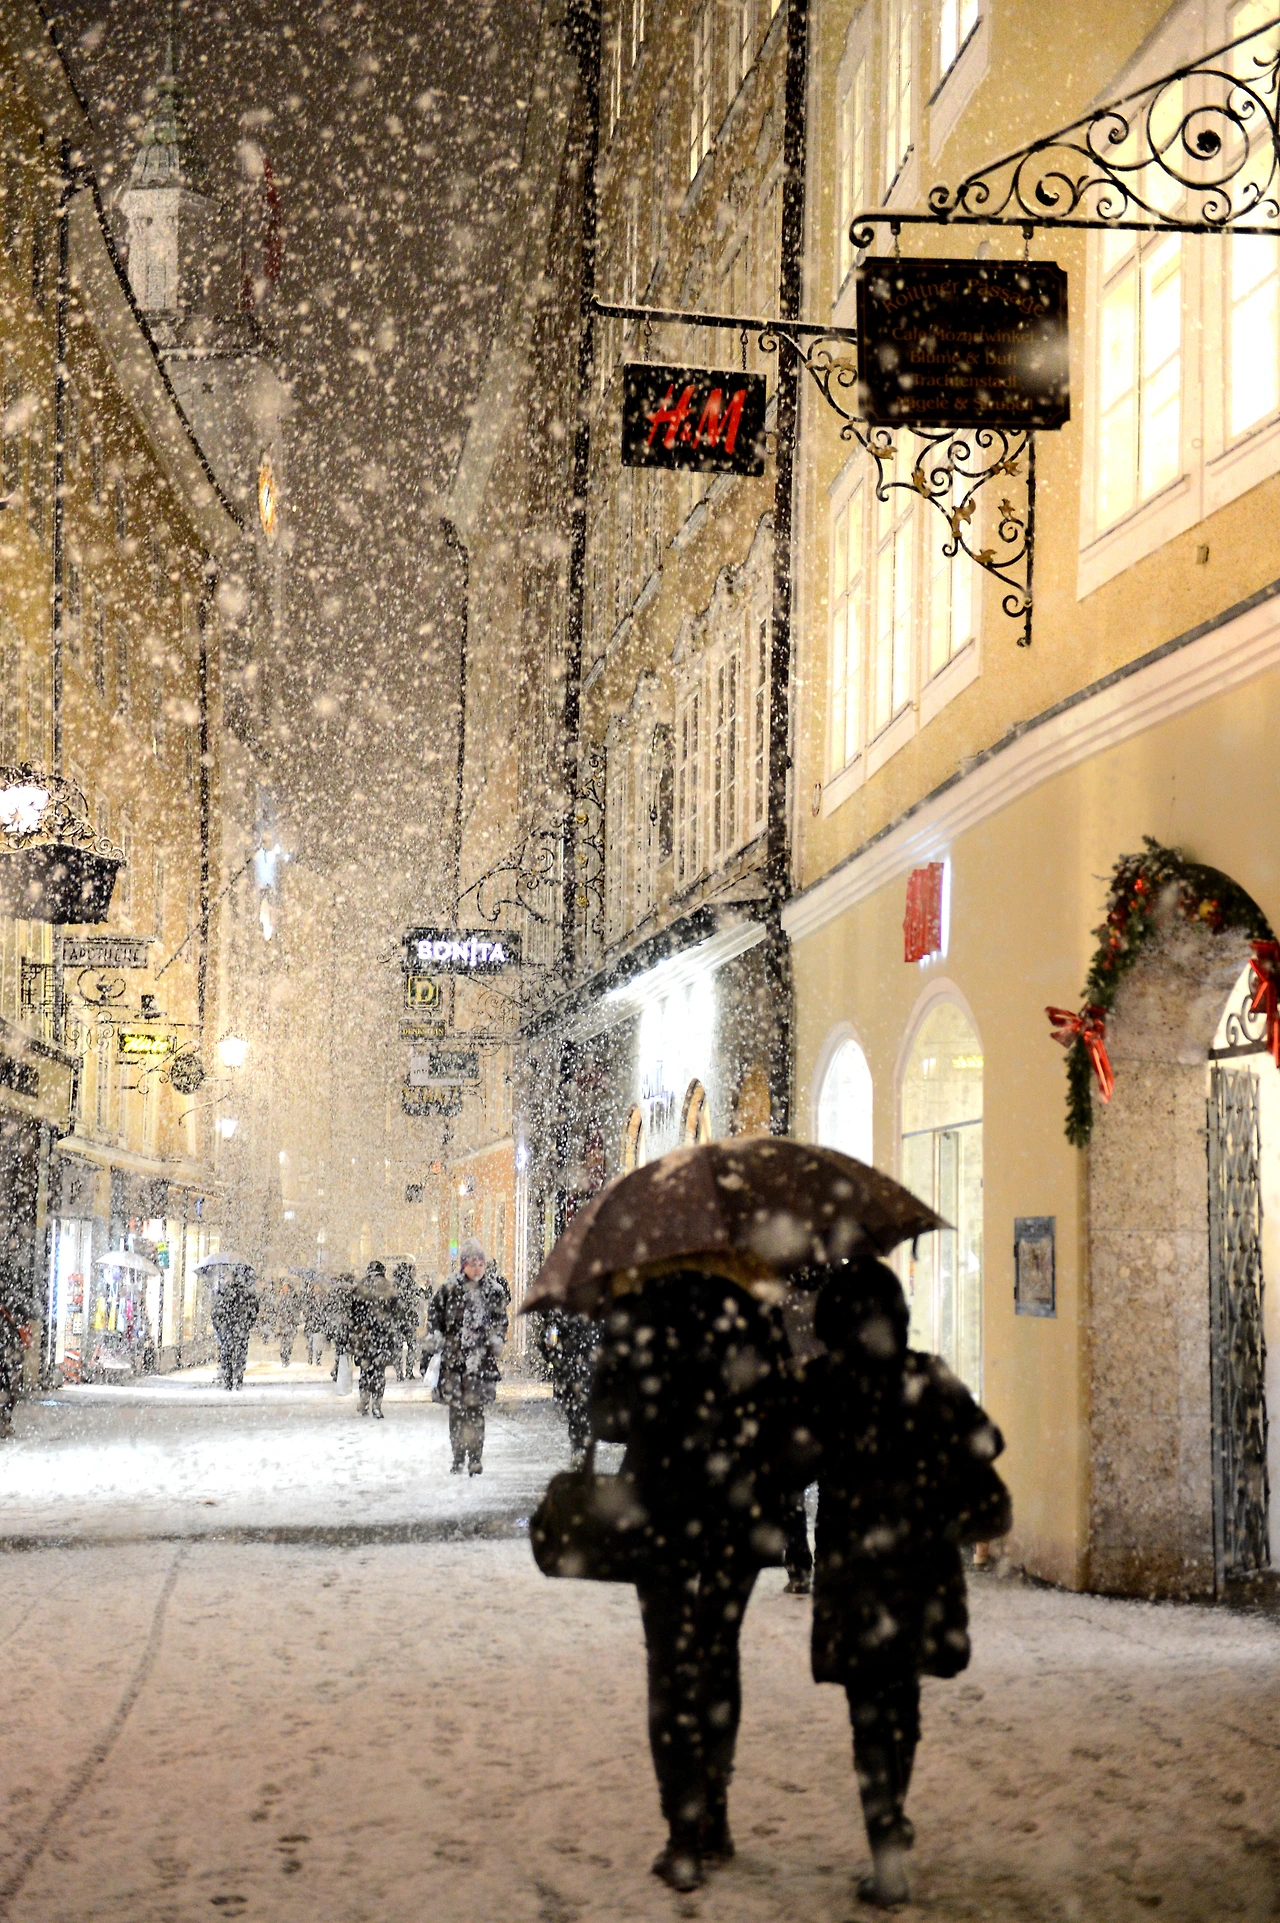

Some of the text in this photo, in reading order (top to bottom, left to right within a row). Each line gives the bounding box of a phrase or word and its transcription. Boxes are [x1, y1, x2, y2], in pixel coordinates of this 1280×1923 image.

[967, 278, 1046, 317] Passage
[965, 352, 979, 365] &
[953, 397, 968, 410] &
[646, 384, 747, 455] H&M
[415, 981, 433, 1002] D
